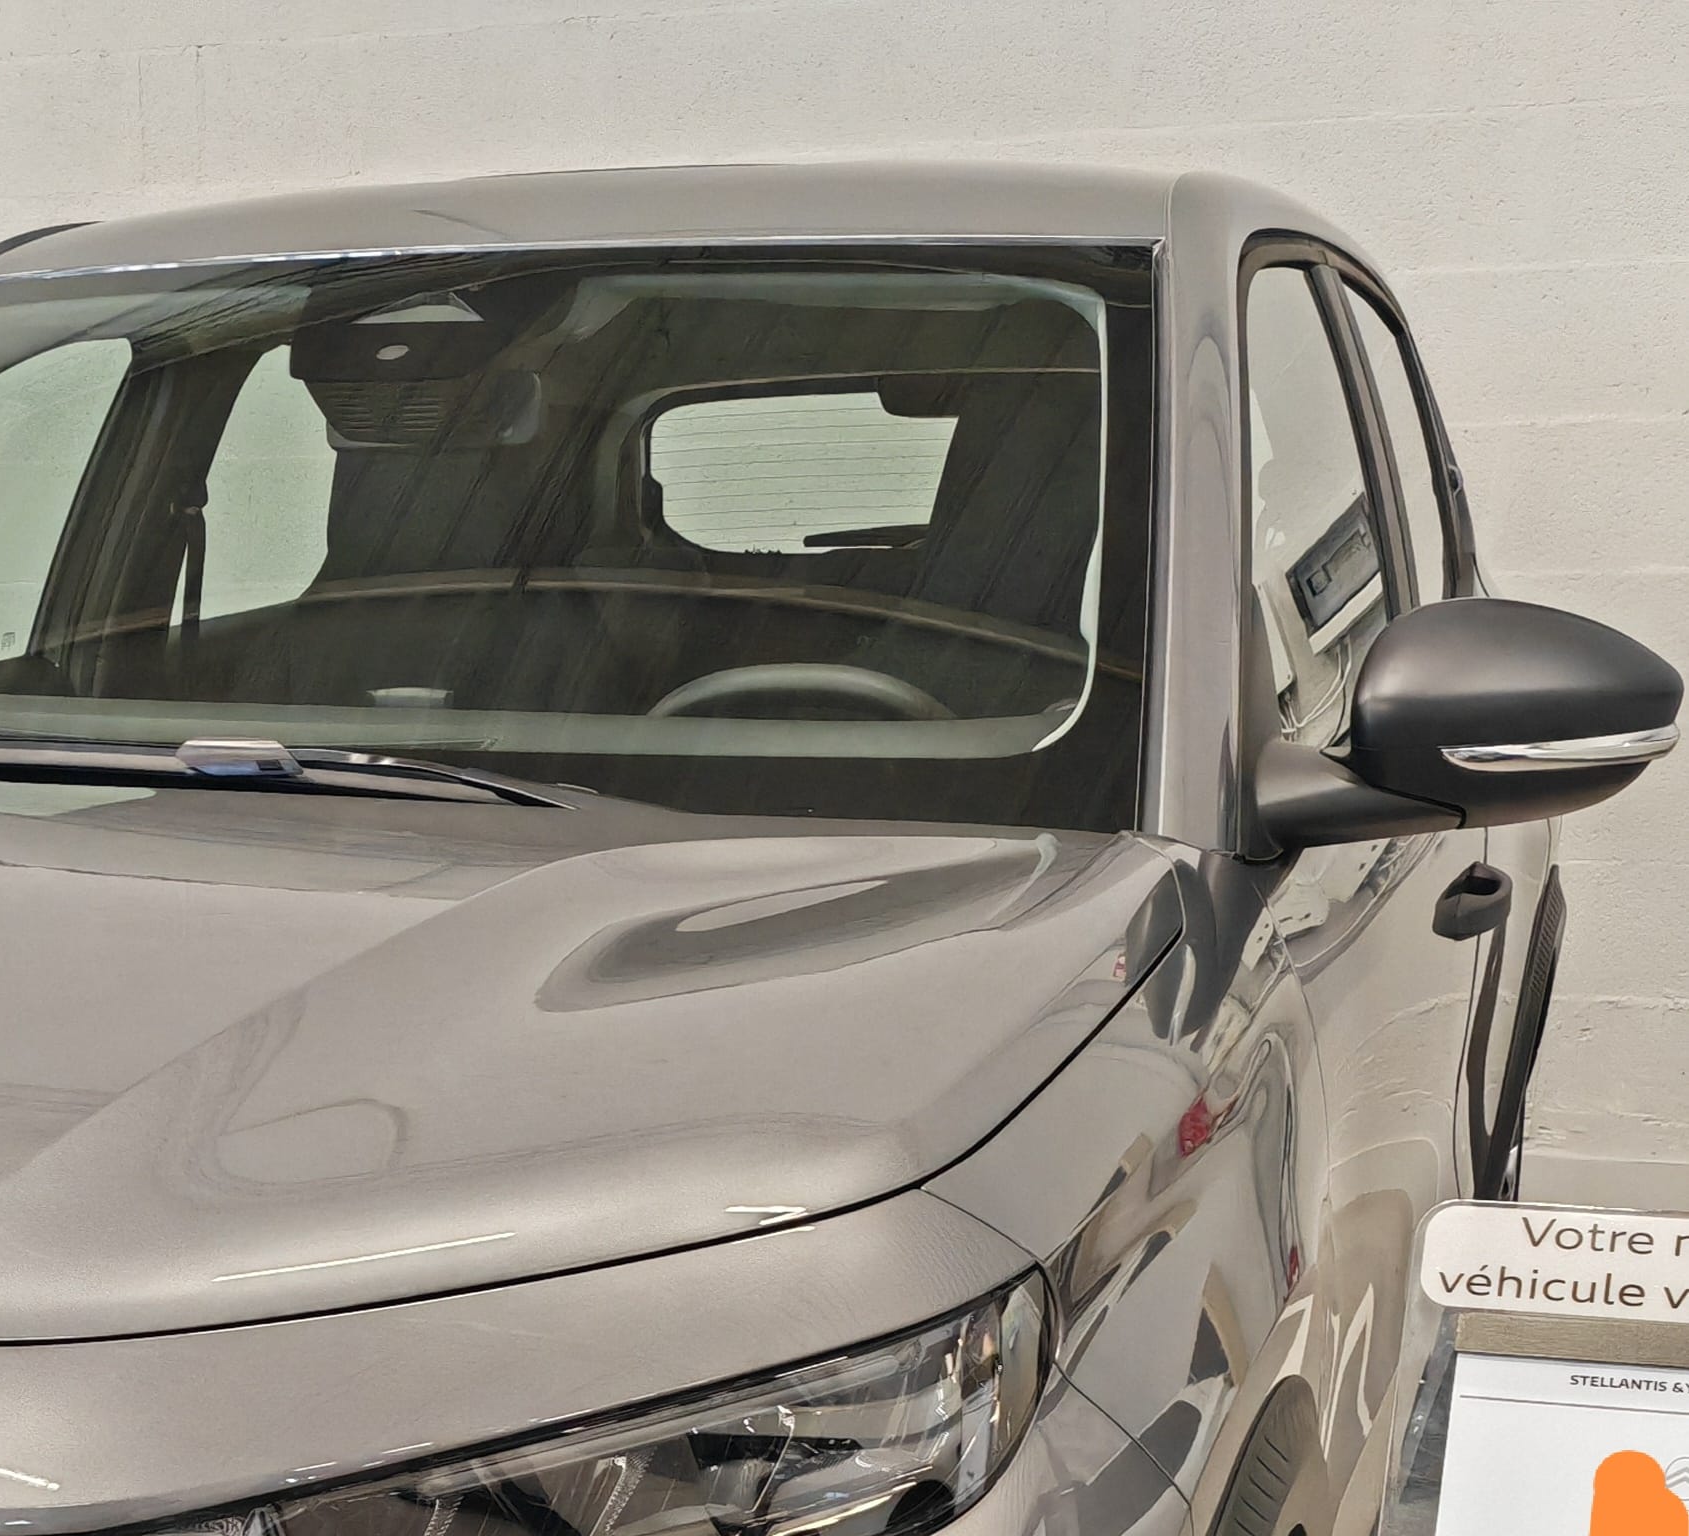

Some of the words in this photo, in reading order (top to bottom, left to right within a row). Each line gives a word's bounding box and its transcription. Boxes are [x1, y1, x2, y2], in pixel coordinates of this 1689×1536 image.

[1521, 1216, 1654, 1255] Votre
[1438, 1264, 1646, 1307] véhicule
[1570, 1374, 1668, 1392] STELLANTIS
